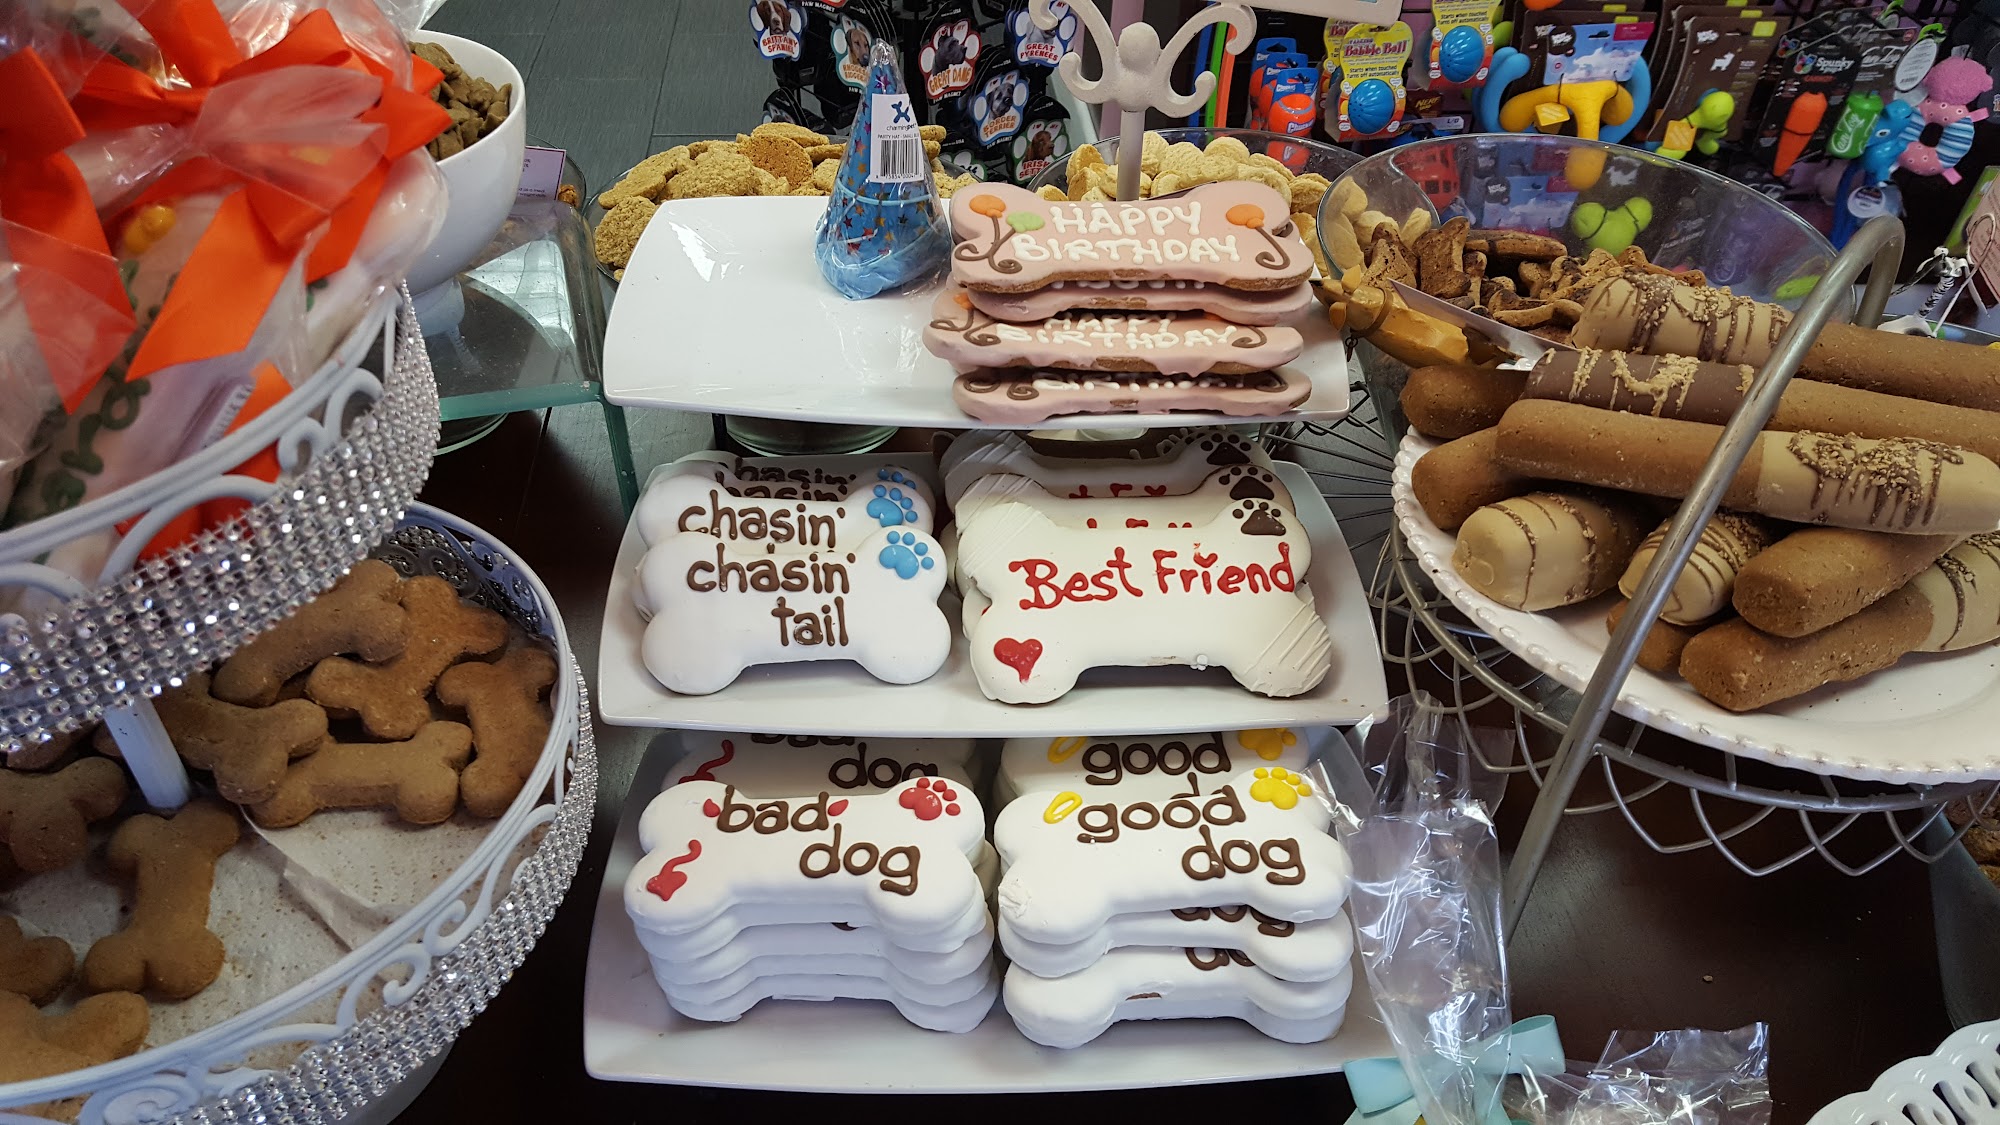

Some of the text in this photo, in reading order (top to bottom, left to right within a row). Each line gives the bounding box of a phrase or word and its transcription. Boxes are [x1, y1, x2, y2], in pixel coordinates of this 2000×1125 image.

[762, 35, 798, 48] BRITTANY
[767, 43, 795, 54] SPANIEL
[1020, 49, 1059, 62] PYRENEES
[1026, 43, 1056, 52] GREAT
[1344, 43, 1381, 56] Babble
[1383, 41, 1408, 54] Ball
[928, 66, 973, 93] GREAT DANE
[1815, 57, 1856, 72] Spunky
[983, 115, 1017, 132] BORDER
[984, 122, 1016, 138] TERRIER
[1049, 201, 1201, 236] HAPPY
[1010, 233, 1241, 265] BIRTHDAY
[995, 325, 1237, 350] BIRTHDAY
[678, 489, 846, 548] chasin'
[686, 542, 856, 594] chasin'
[1008, 542, 1296, 610] Best Friend
[770, 595, 849, 647] tail
[1081, 732, 1232, 786] good
[716, 784, 830, 835] bad
[1076, 784, 1247, 844] good
[799, 823, 921, 897] dog
[1181, 824, 1307, 886] dog
